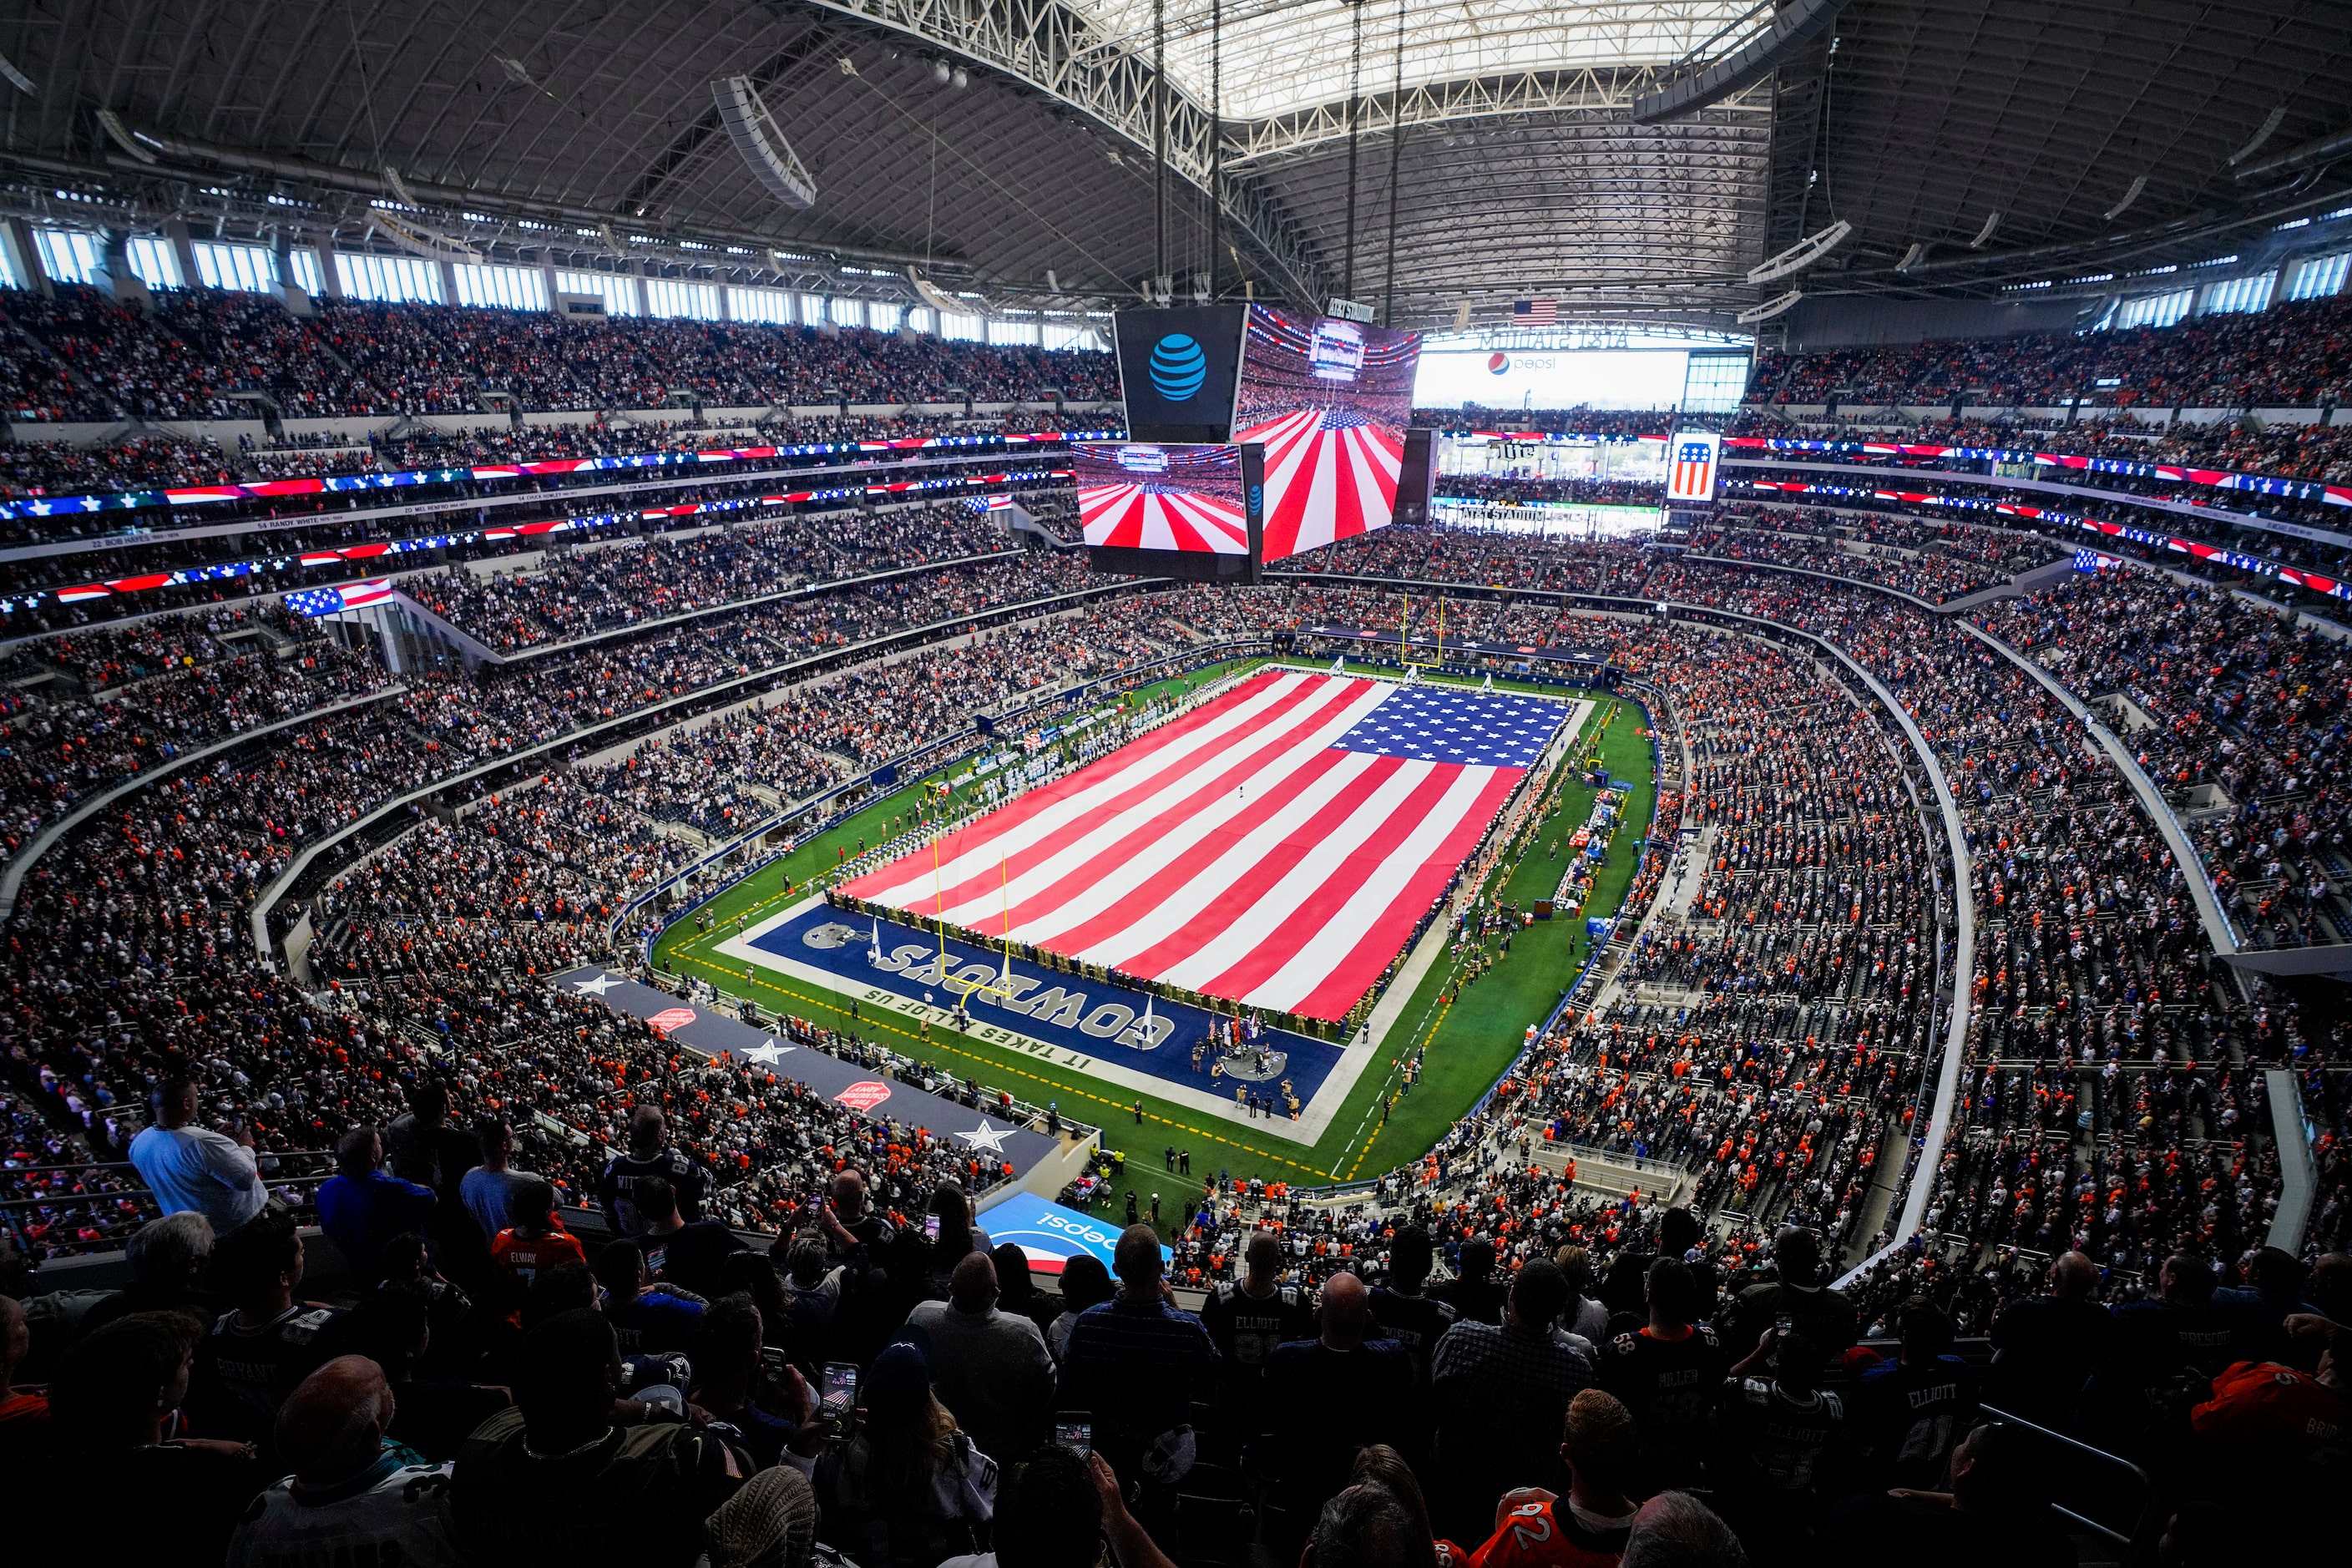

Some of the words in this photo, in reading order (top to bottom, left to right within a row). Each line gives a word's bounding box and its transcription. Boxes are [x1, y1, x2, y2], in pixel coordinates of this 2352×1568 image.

[1328, 297, 1348, 318] AT&T
[1345, 301, 1375, 324] STADIUM
[1514, 357, 1555, 372] pepsi
[296, 517, 317, 525] WHITE
[1461, 508, 1491, 519] AT&T
[1492, 508, 1545, 522] STADIUM
[105, 538, 124, 546] BOB
[864, 990, 894, 1004] US
[876, 944, 1176, 1050] COWBOYS
[897, 1003, 928, 1015] OF
[980, 1028, 1055, 1059] TAKES
[1062, 1055, 1091, 1070] IT
[510, 1252, 537, 1264] ELWAY
[516, 1267, 536, 1290] 7
[1236, 1316, 1280, 1329] ELLIOTT
[1611, 1333, 1636, 1356] 58
[1698, 1324, 1720, 1348] 58
[216, 1356, 281, 1382] BRYANT
[1657, 1367, 1699, 1388] MILLER
[1909, 1383, 1957, 1409] ELLIOTT
[1768, 1421, 1829, 1444] ELLIOTT
[1897, 1414, 1954, 1462] 21
[1510, 1503, 1550, 1551] 92
